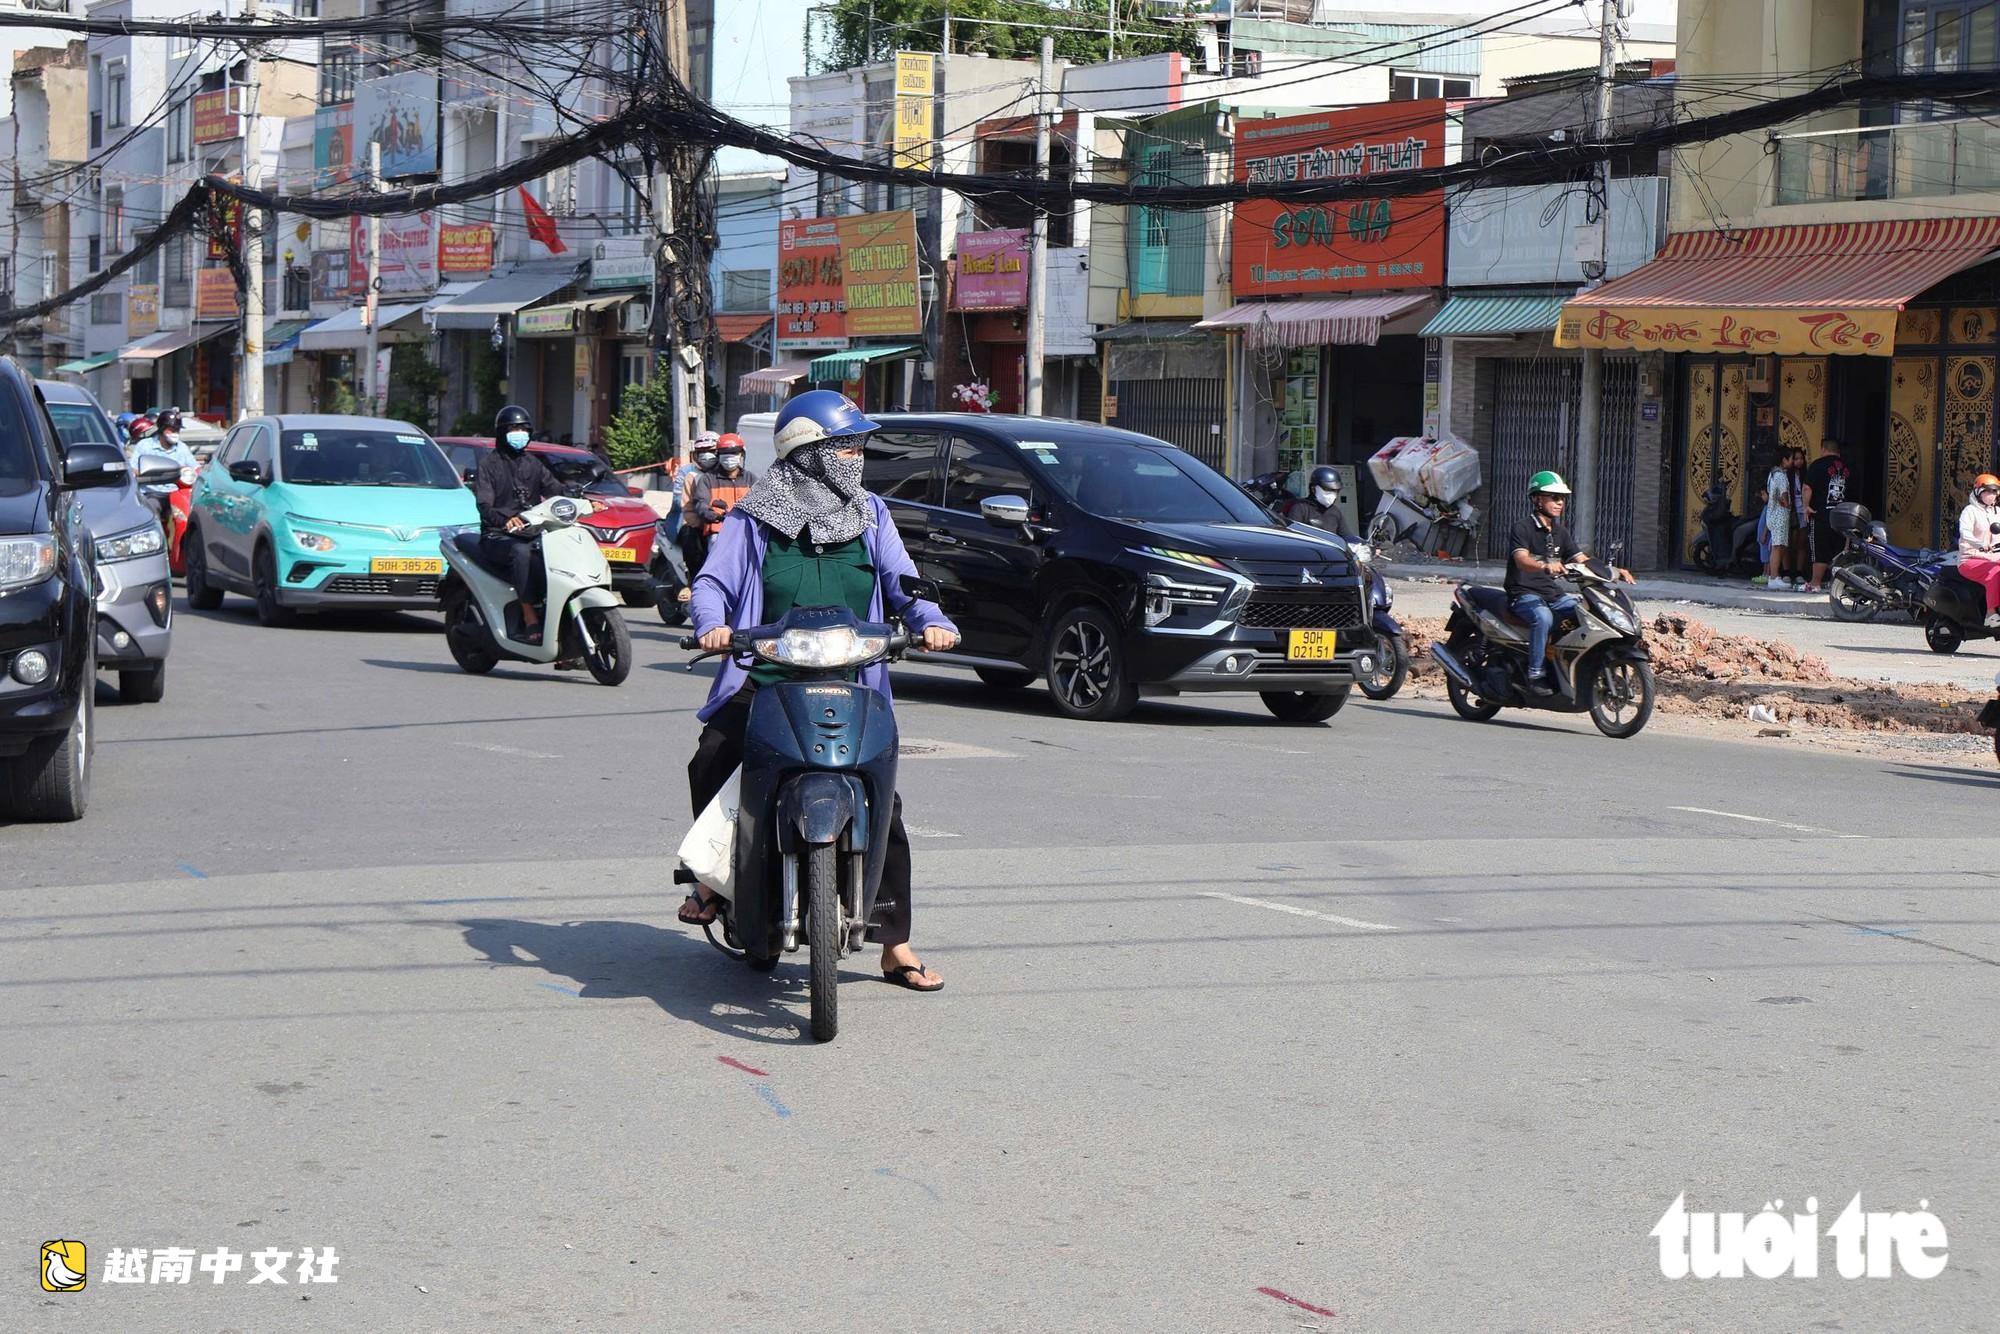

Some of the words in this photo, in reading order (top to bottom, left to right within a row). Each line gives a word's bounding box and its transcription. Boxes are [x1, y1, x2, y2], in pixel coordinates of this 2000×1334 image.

[1246, 153, 1299, 184] TRUNG
[1301, 146, 1336, 180] TÂM
[1272, 205, 1336, 250] SƠN
[847, 245, 874, 276] DỊCH
[876, 240, 909, 275] THUẬT
[1250, 265, 1263, 283] 10
[847, 279, 883, 309] KHÁNH
[885, 278, 917, 308] BĂNG
[1586, 309, 1702, 342] Phước
[1711, 315, 1781, 350] Lộc
[294, 444, 319, 452] TAXI
[377, 561, 437, 572] 50H-385.26
[1303, 631, 1323, 644] 90H
[1293, 646, 1329, 659] 021.51
[806, 687, 851, 696] HONDA
